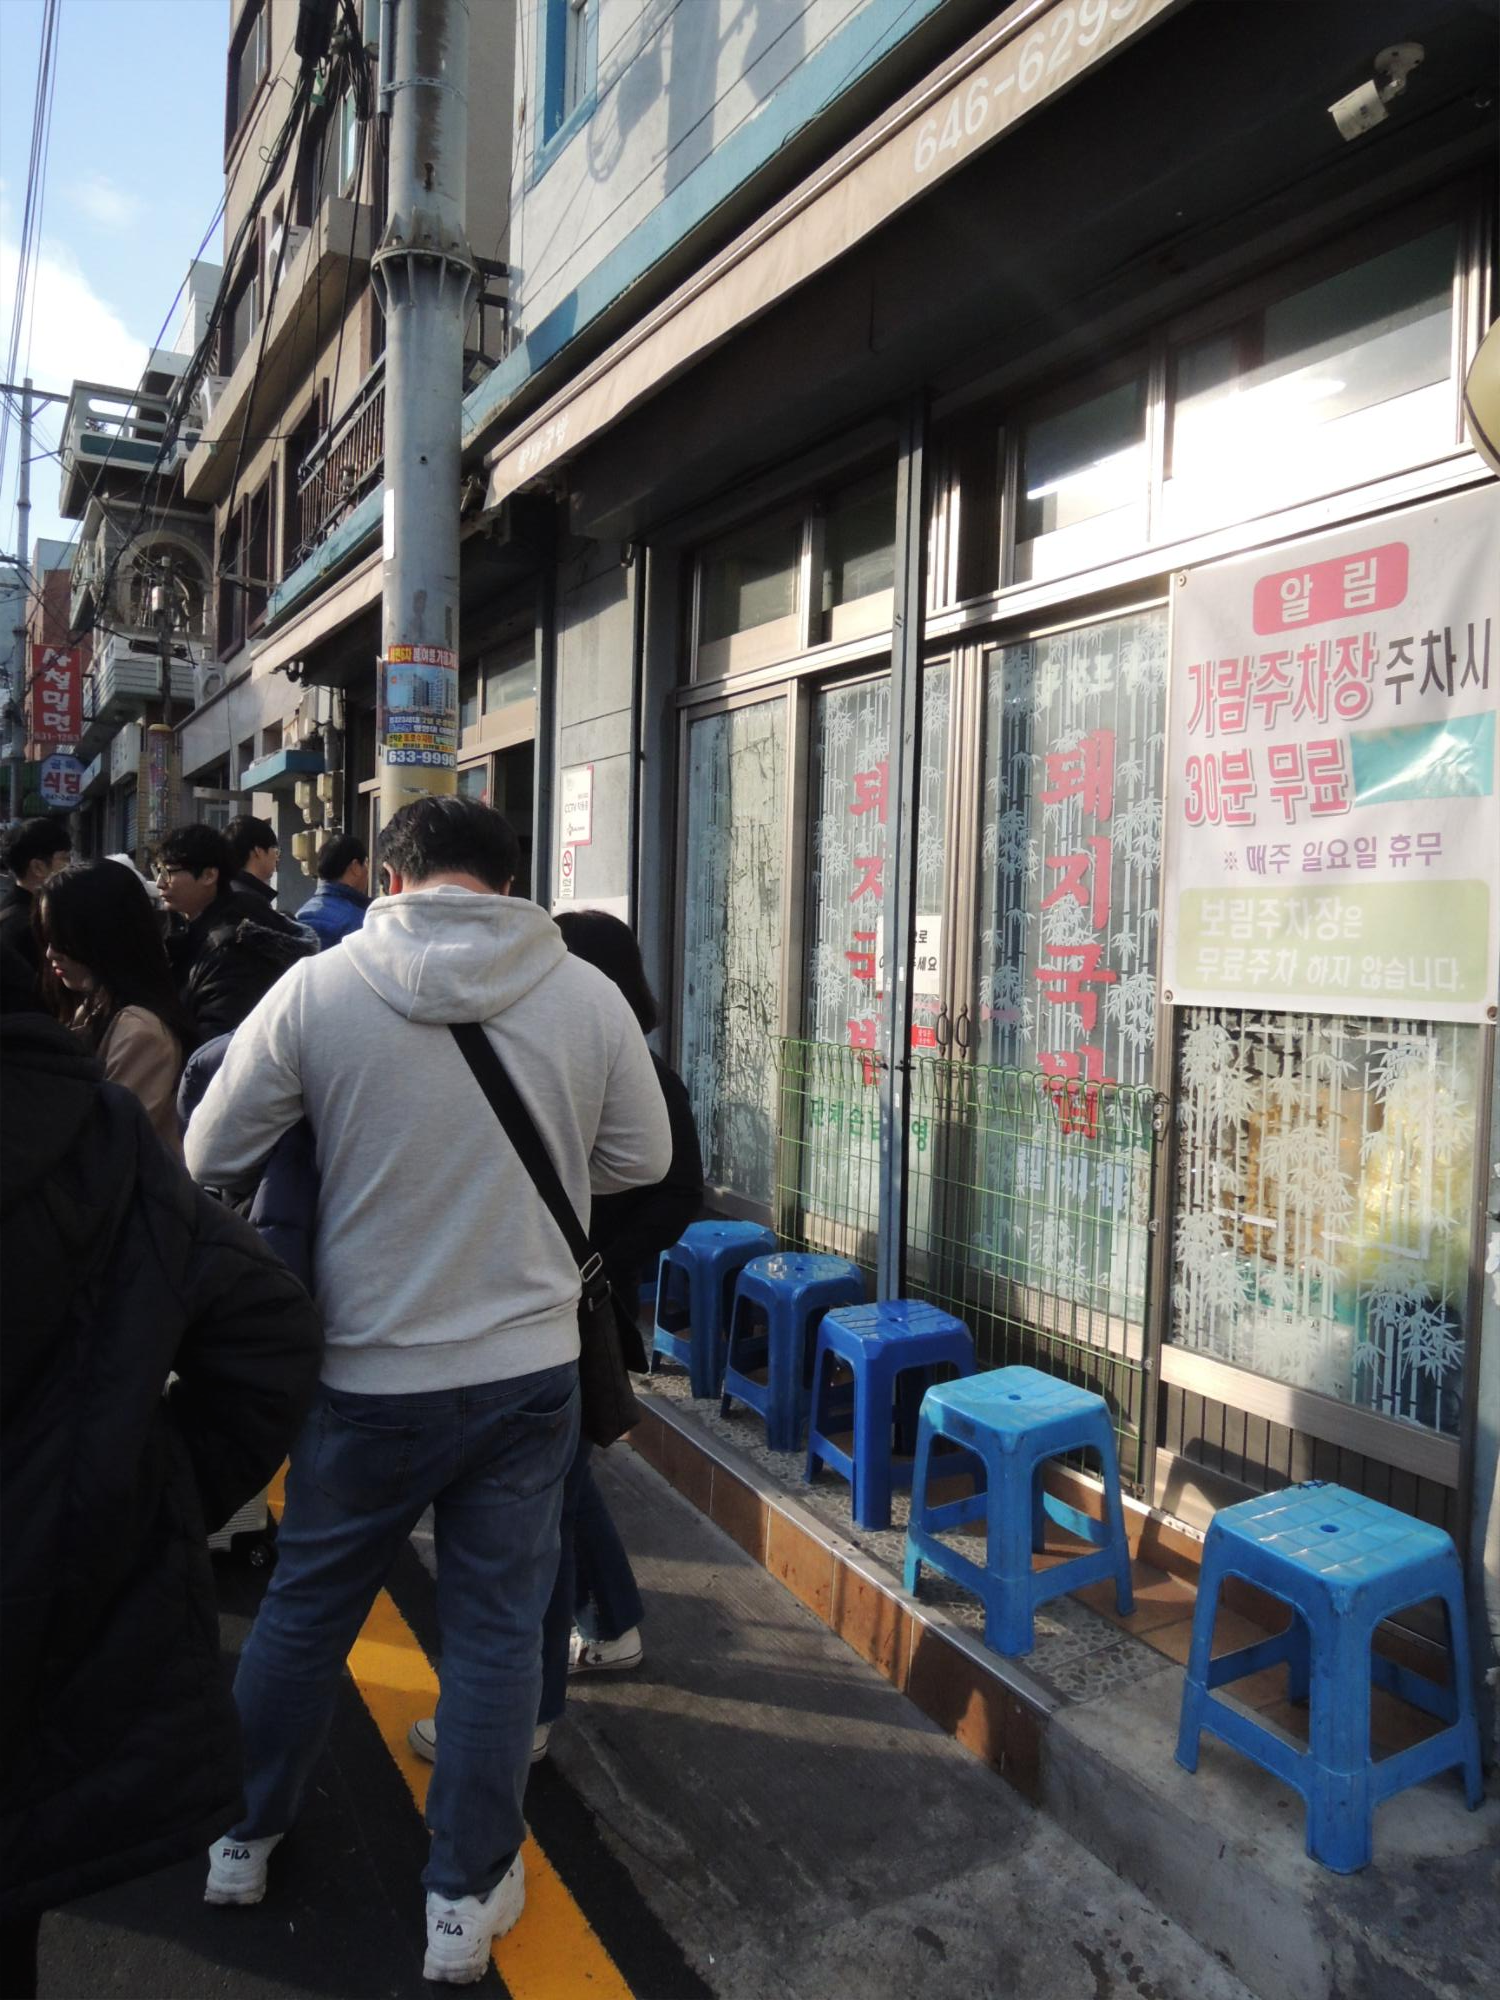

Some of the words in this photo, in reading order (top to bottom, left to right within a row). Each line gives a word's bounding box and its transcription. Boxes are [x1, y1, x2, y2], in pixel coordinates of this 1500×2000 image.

[1187, 631, 1377, 738] 가람주차장
[1384, 618, 1492, 706] 주차시
[388, 750, 455, 766] 633-9996
[44, 772, 81, 794] 식당
[1184, 747, 1255, 826] 30분
[1267, 738, 1352, 824] 무료
[1246, 843, 1291, 876] 매주
[1301, 835, 1378, 873] 일요일
[1387, 831, 1444, 869] 휴무
[1034, 729, 1118, 1139] 돼지국밥
[1196, 895, 1364, 941] 보림주차장은
[1195, 946, 1298, 988] 무료주차
[1306, 953, 1352, 987] 하지
[1359, 954, 1466, 993] 않습니다.
[222, 1848, 251, 1861] FILA
[435, 1919, 464, 1938] FILA
